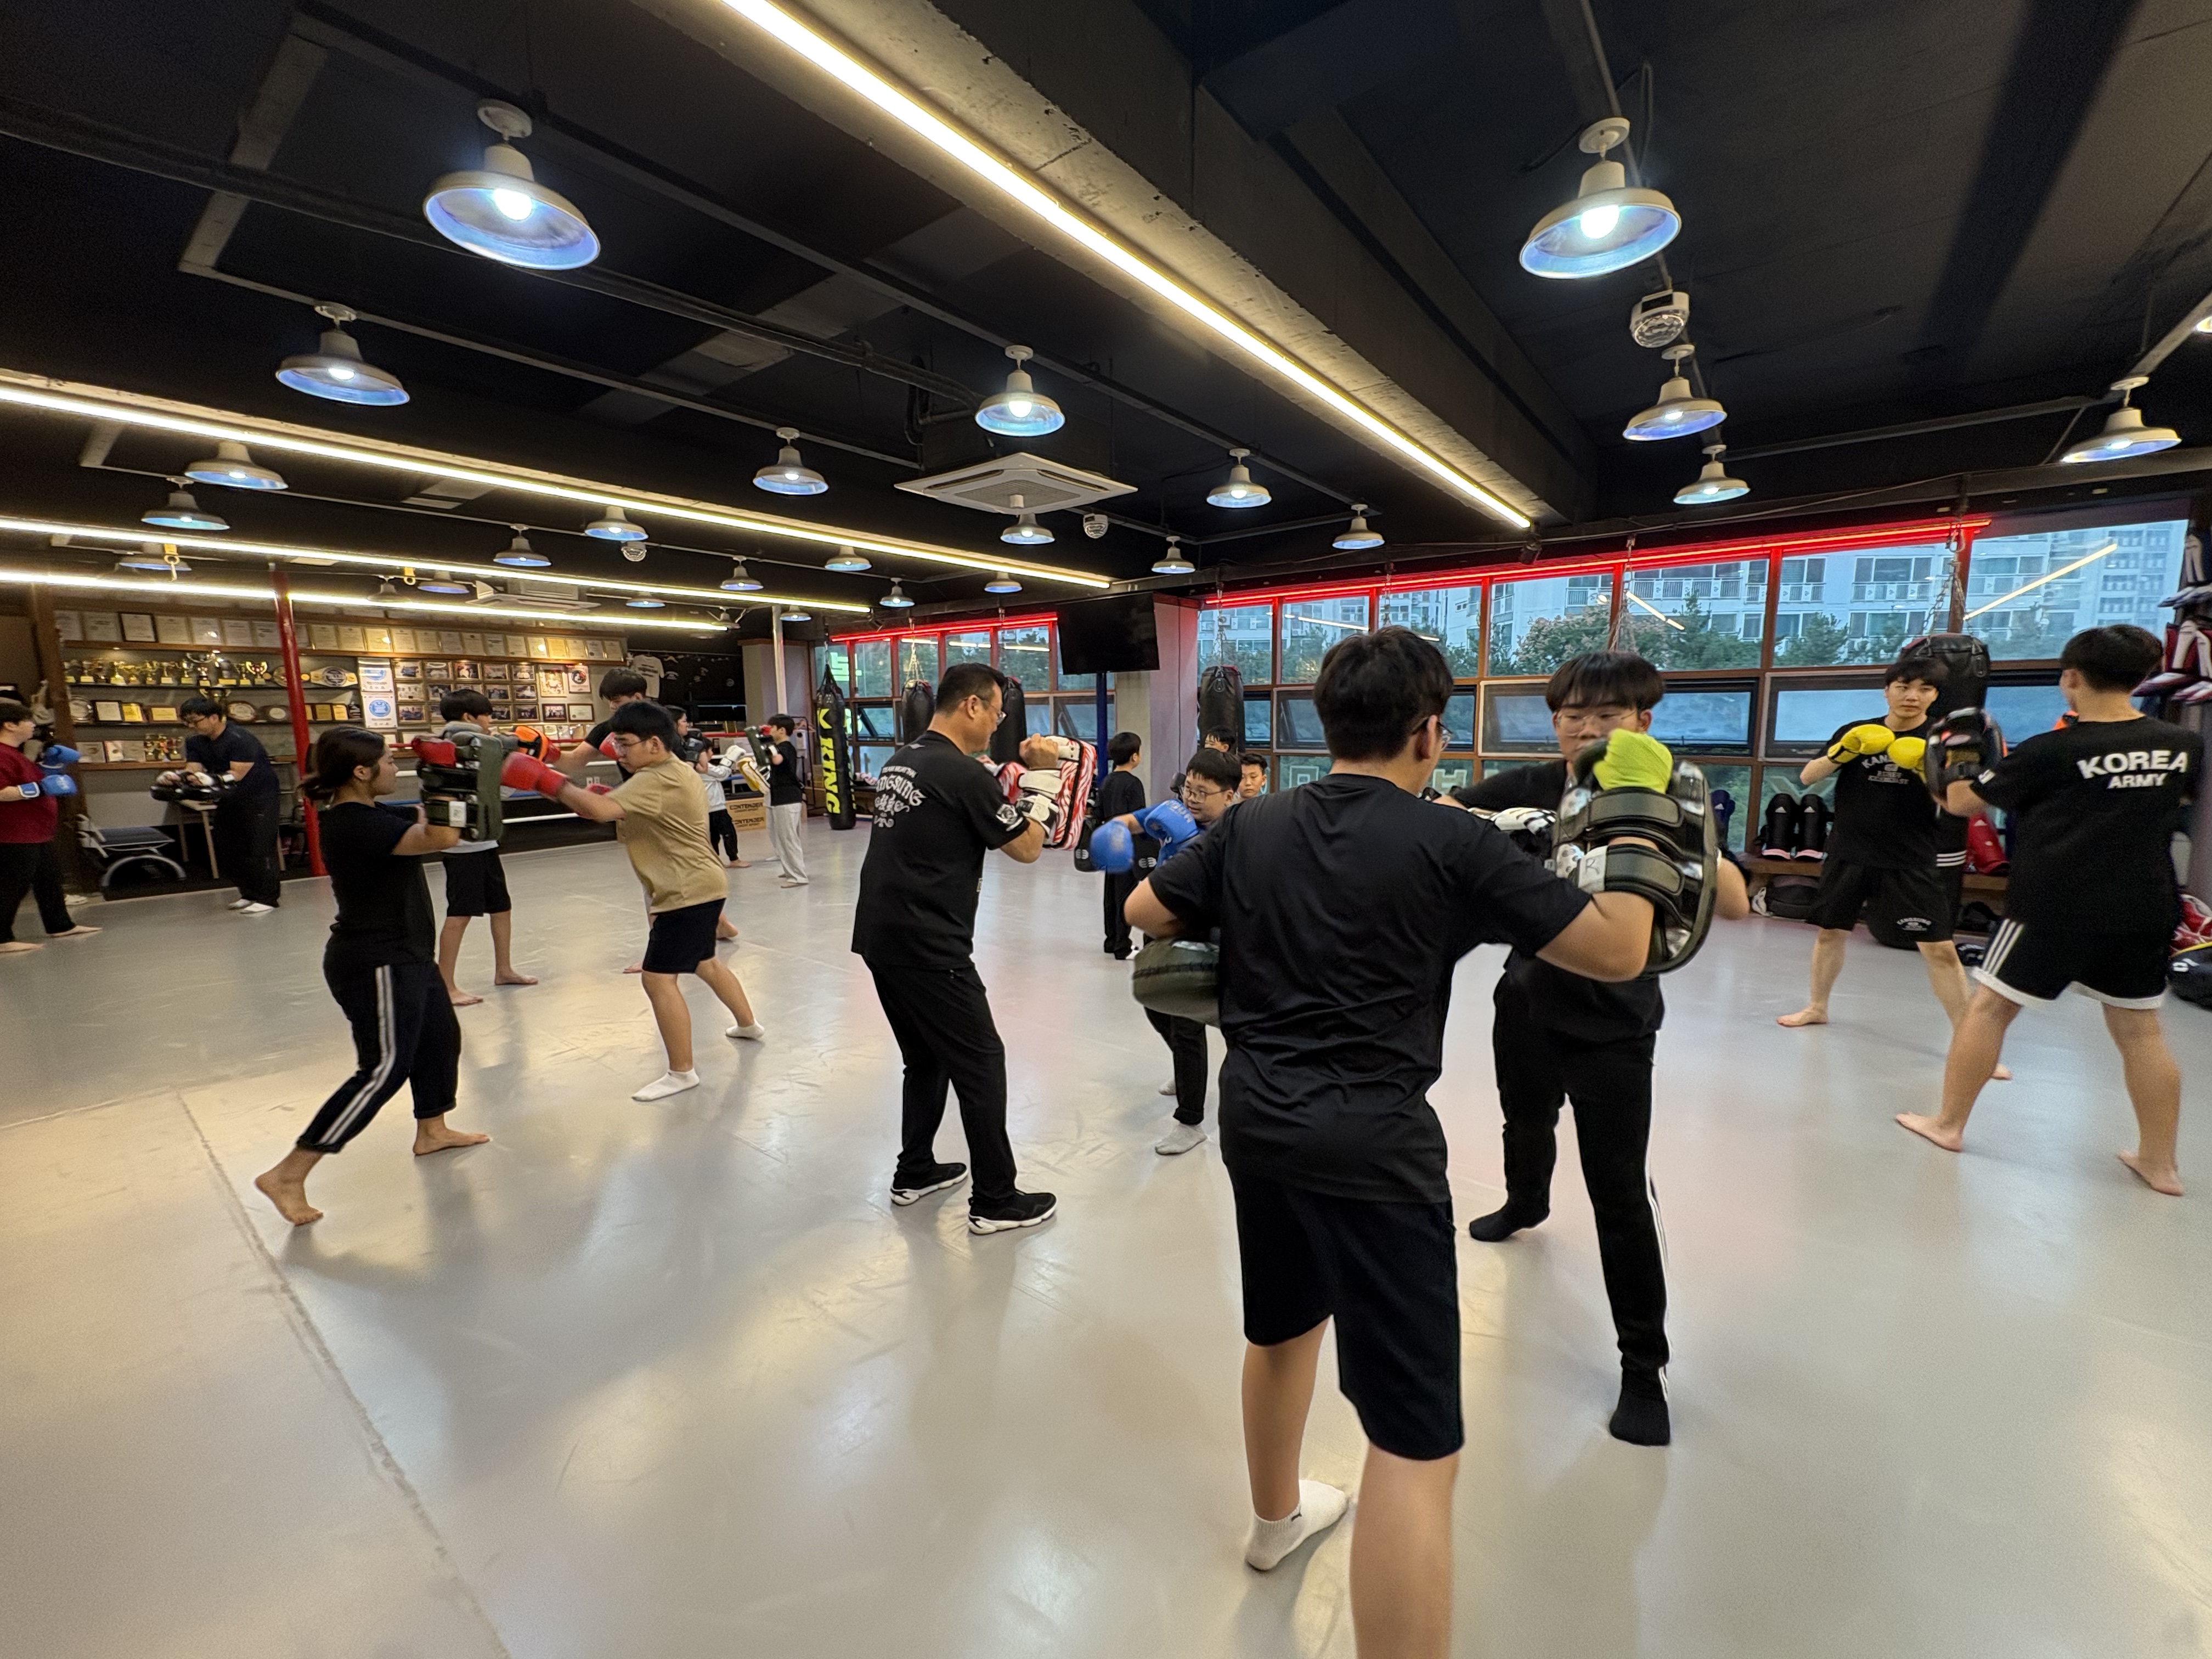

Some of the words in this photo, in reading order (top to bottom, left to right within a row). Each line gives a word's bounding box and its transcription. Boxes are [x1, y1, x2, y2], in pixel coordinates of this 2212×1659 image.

[2076, 750, 2188, 779] KOREA
[2107, 772, 2168, 789] ARMY
[1585, 857, 1600, 874] R
